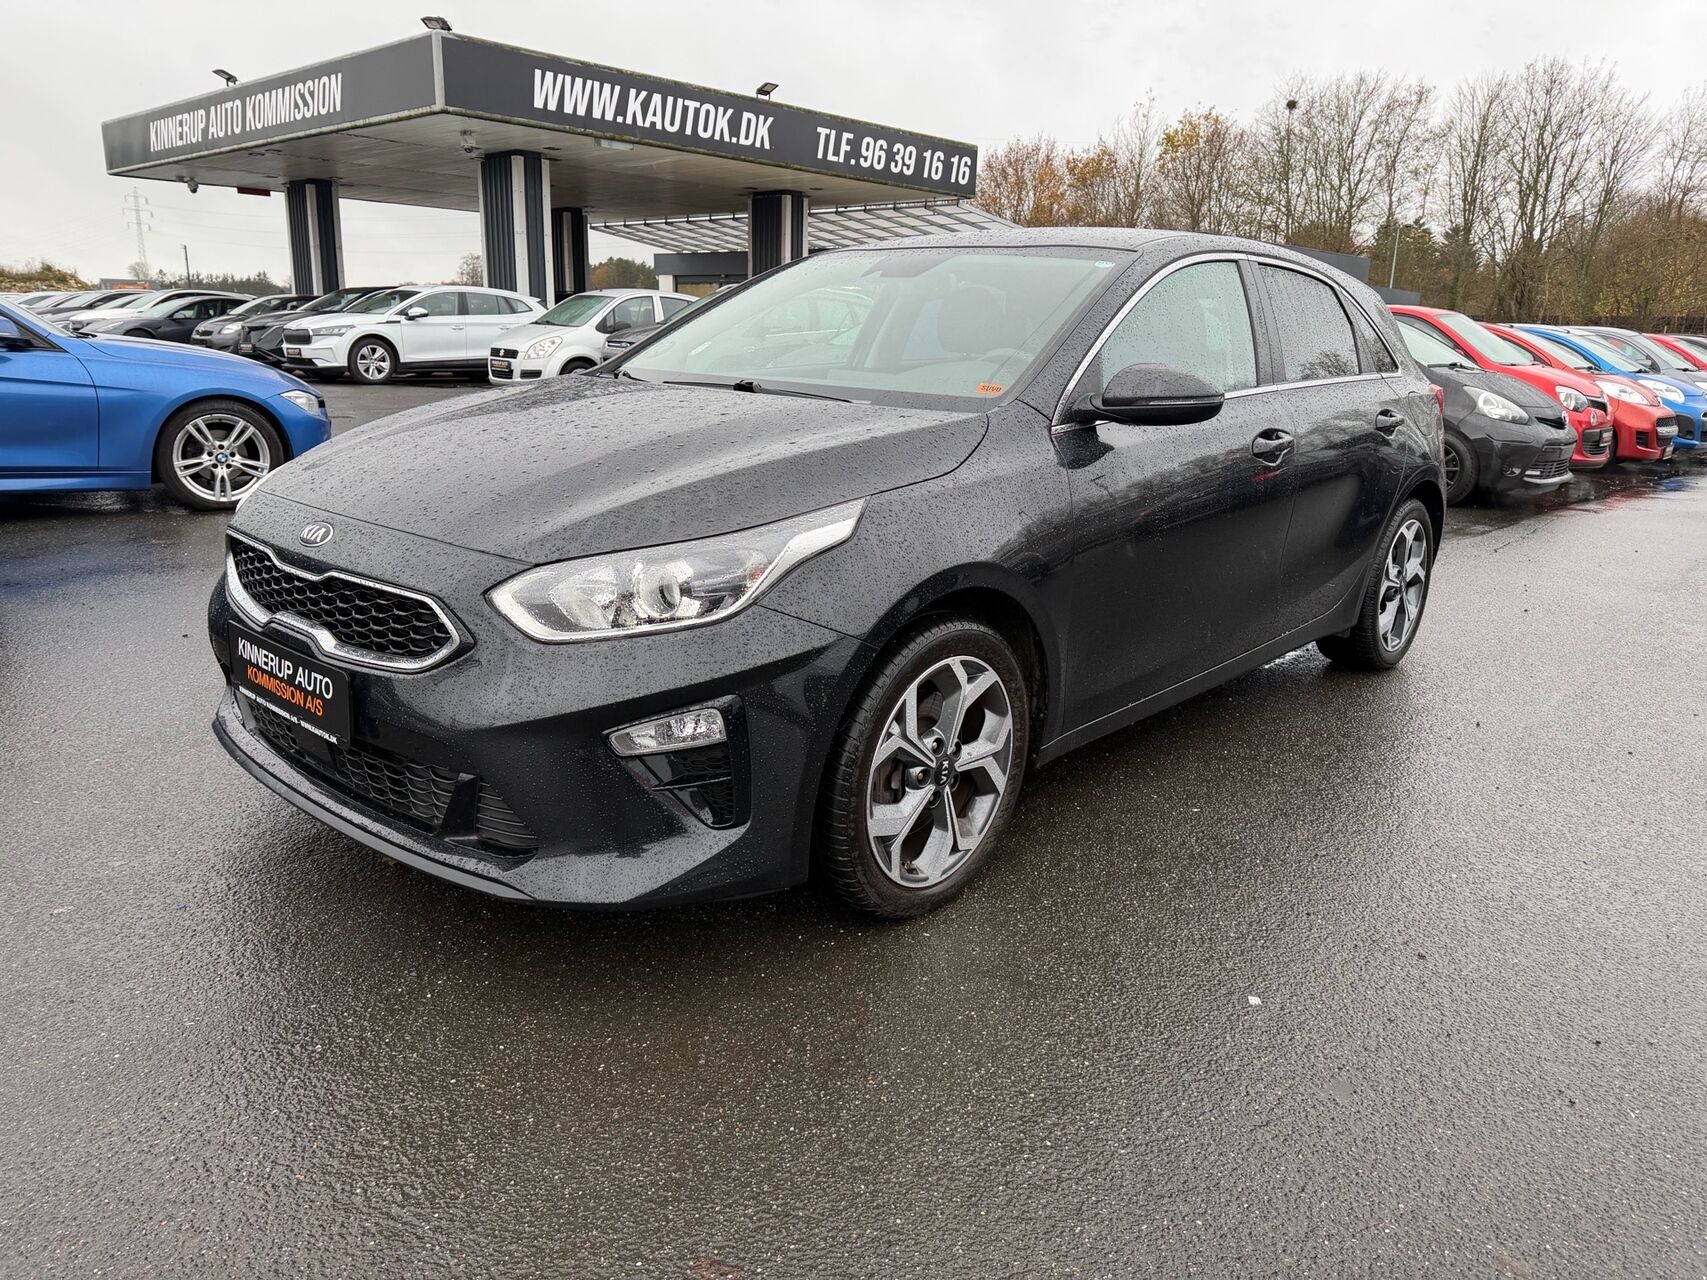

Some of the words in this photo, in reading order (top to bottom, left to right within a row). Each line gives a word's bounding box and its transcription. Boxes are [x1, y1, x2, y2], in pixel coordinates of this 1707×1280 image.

[149, 109, 206, 153] KINNERUP
[208, 99, 242, 140] AUTO
[245, 73, 342, 132] KOMMISSION
[533, 68, 775, 150] WWW.KAUTOK.DK
[816, 126, 856, 165] TLF.
[859, 136, 888, 170] 96
[890, 143, 917, 176] 39
[923, 149, 945, 181] 16
[950, 154, 972, 185] 16
[300, 523, 327, 543] KIA
[238, 636, 293, 681] KINNERUP
[295, 665, 334, 700] AUTO
[247, 664, 305, 708] KOMMISSION
[305, 694, 324, 717] A/S
[939, 760, 950, 784] KIA
